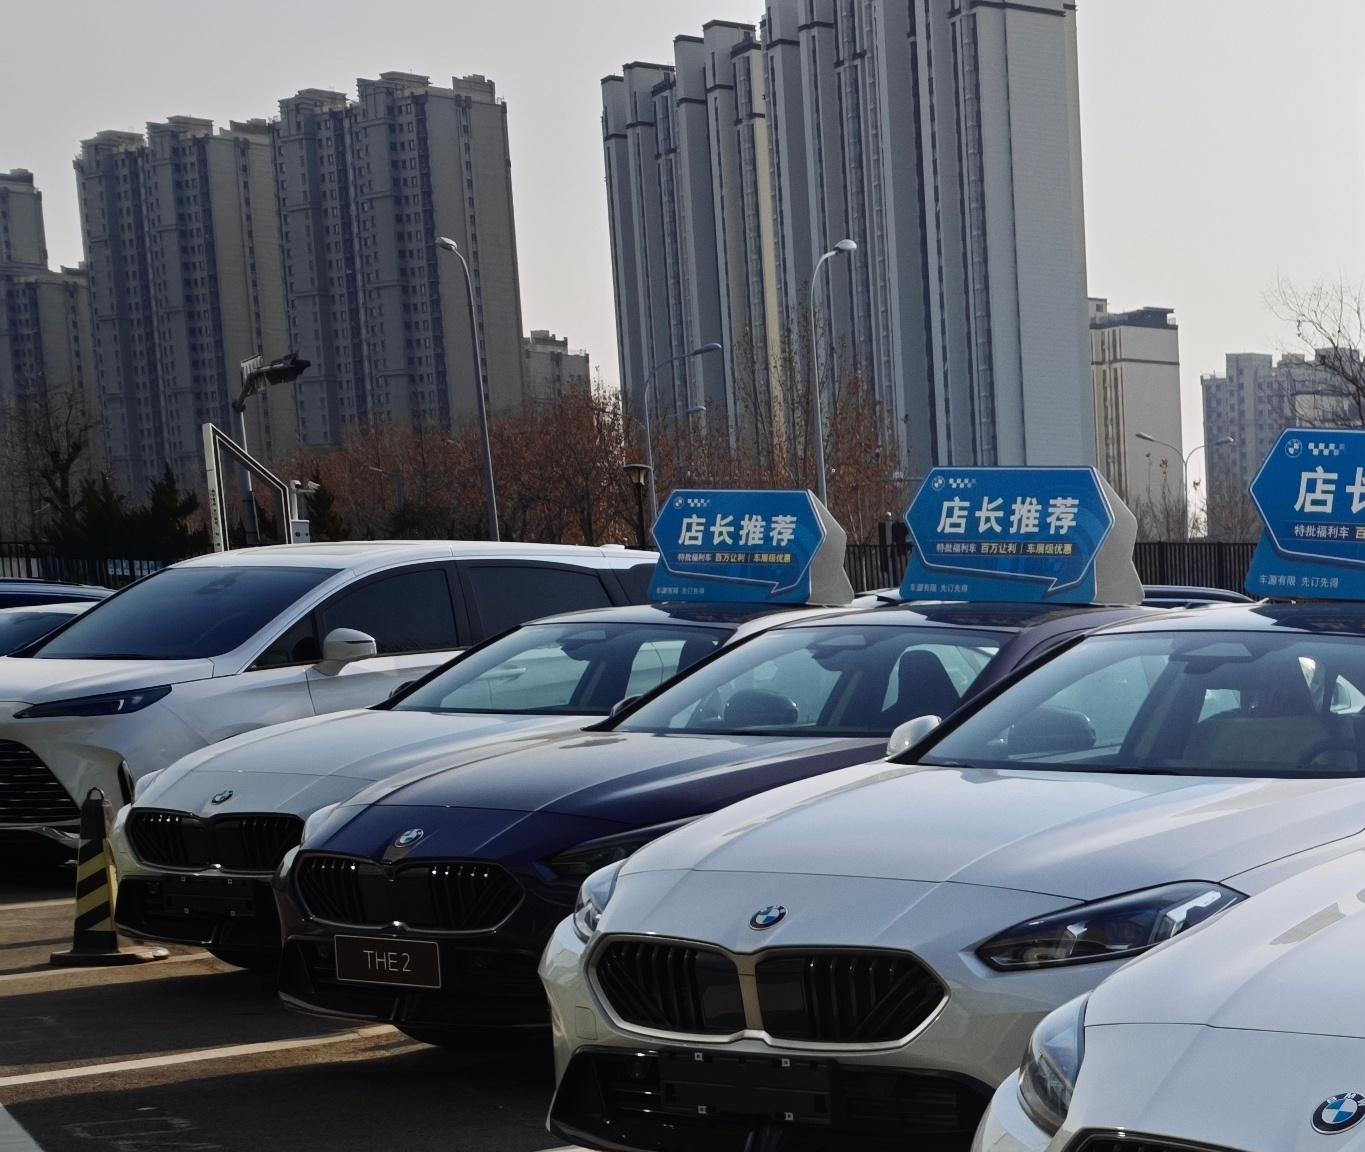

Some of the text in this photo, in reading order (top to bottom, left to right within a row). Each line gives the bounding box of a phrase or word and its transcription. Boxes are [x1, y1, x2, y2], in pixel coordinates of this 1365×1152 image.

[678, 513, 797, 546] 店长推荐
[936, 496, 1080, 535] 店长推荐
[1293, 523, 1349, 539] 特批福利车
